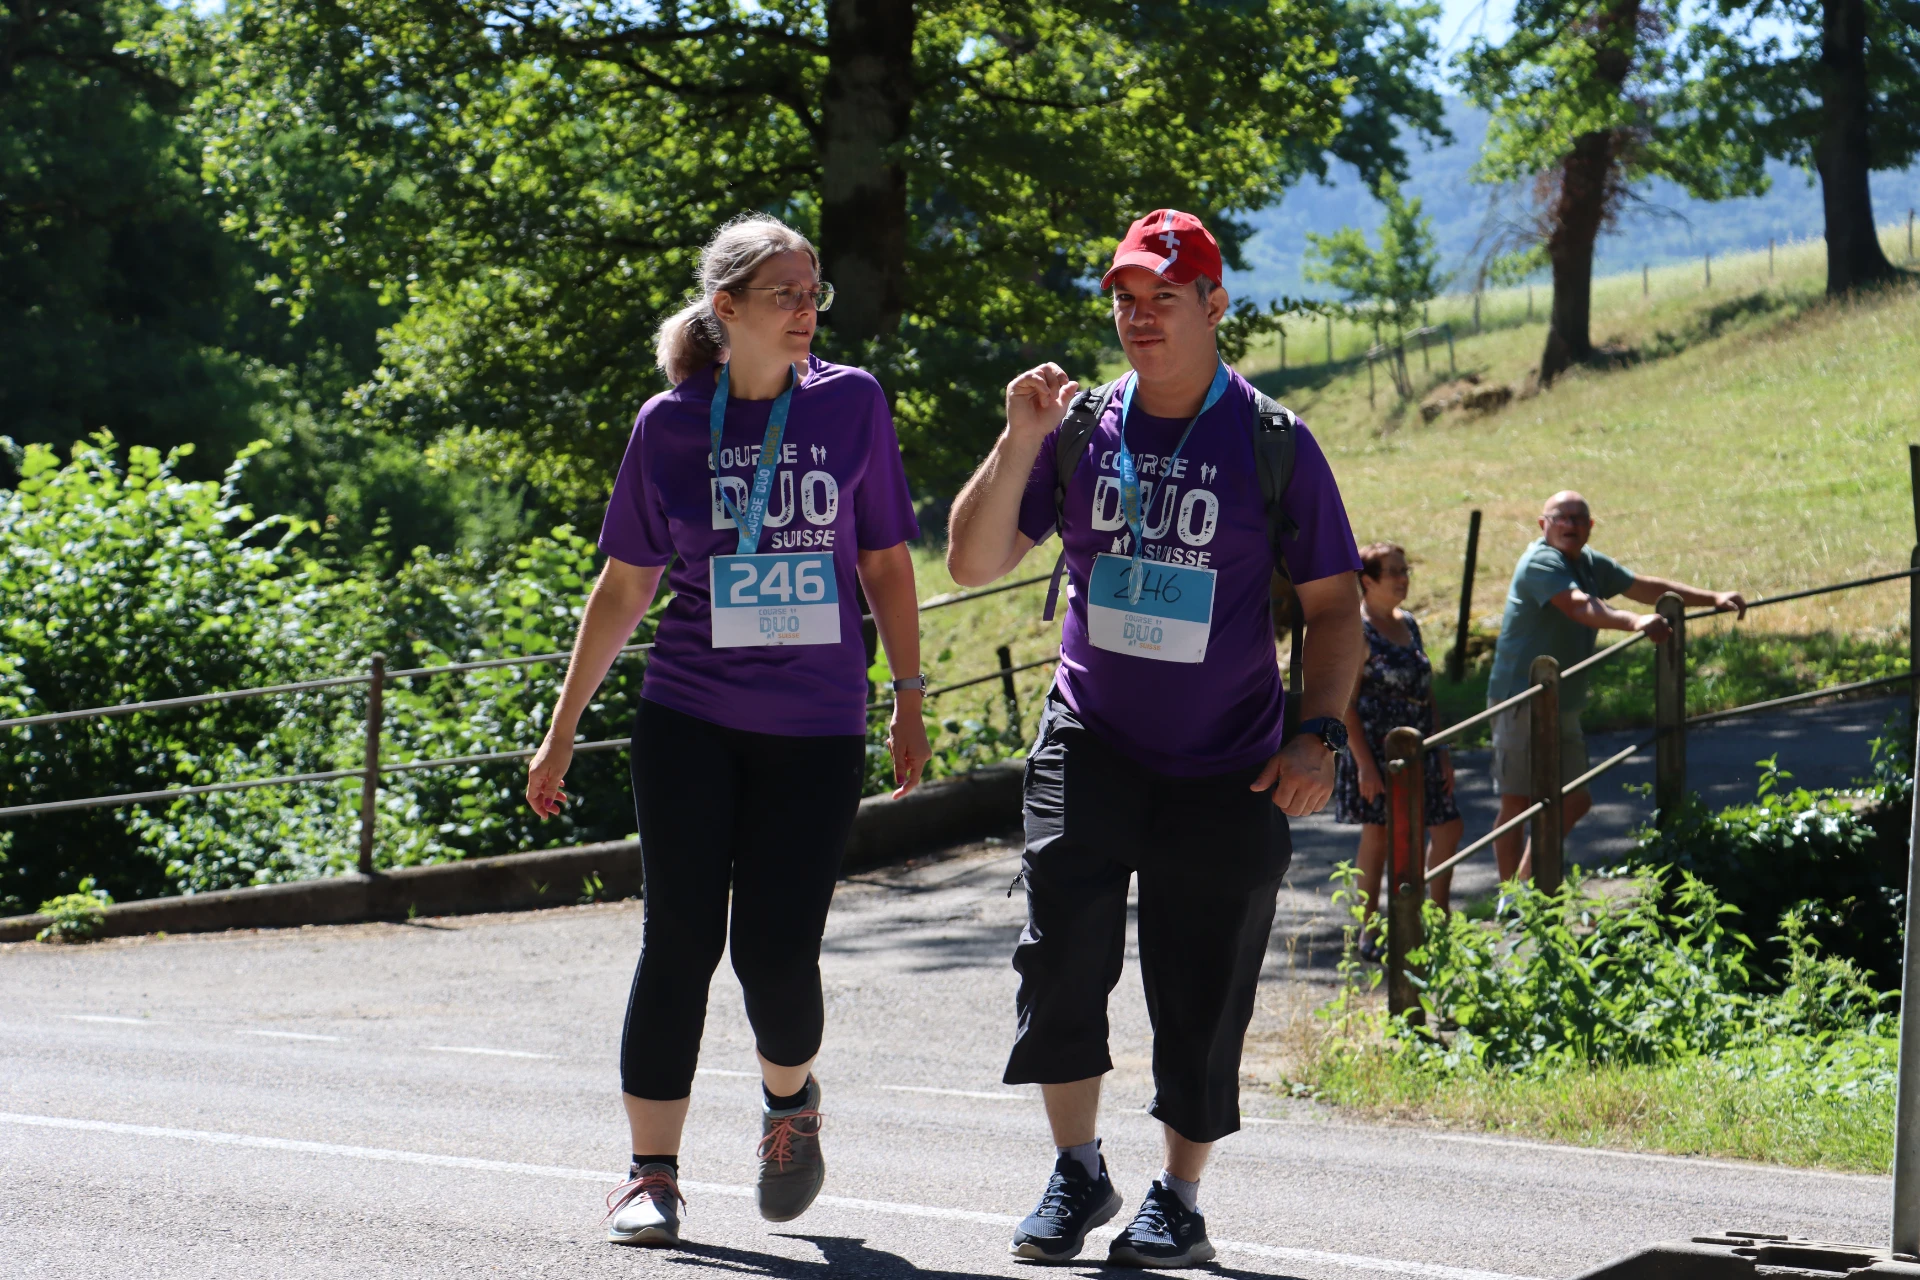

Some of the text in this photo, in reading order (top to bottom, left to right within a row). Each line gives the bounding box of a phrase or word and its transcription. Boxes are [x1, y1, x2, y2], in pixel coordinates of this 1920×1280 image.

[748, 425, 781, 538] OURSE DUO SUISSE
[711, 470, 839, 530] DUO
[1091, 475, 1219, 546] DUO
[771, 529, 836, 549] SUISSE
[1143, 544, 1212, 569] SUISSE
[730, 560, 826, 604] 246
[1113, 567, 1182, 603] 246
[758, 608, 787, 616] COURSE
[1124, 613, 1153, 625] COURSE
[759, 616, 800, 633] DUO
[1122, 622, 1163, 644] DUO
[1139, 642, 1162, 651] SUISSE
